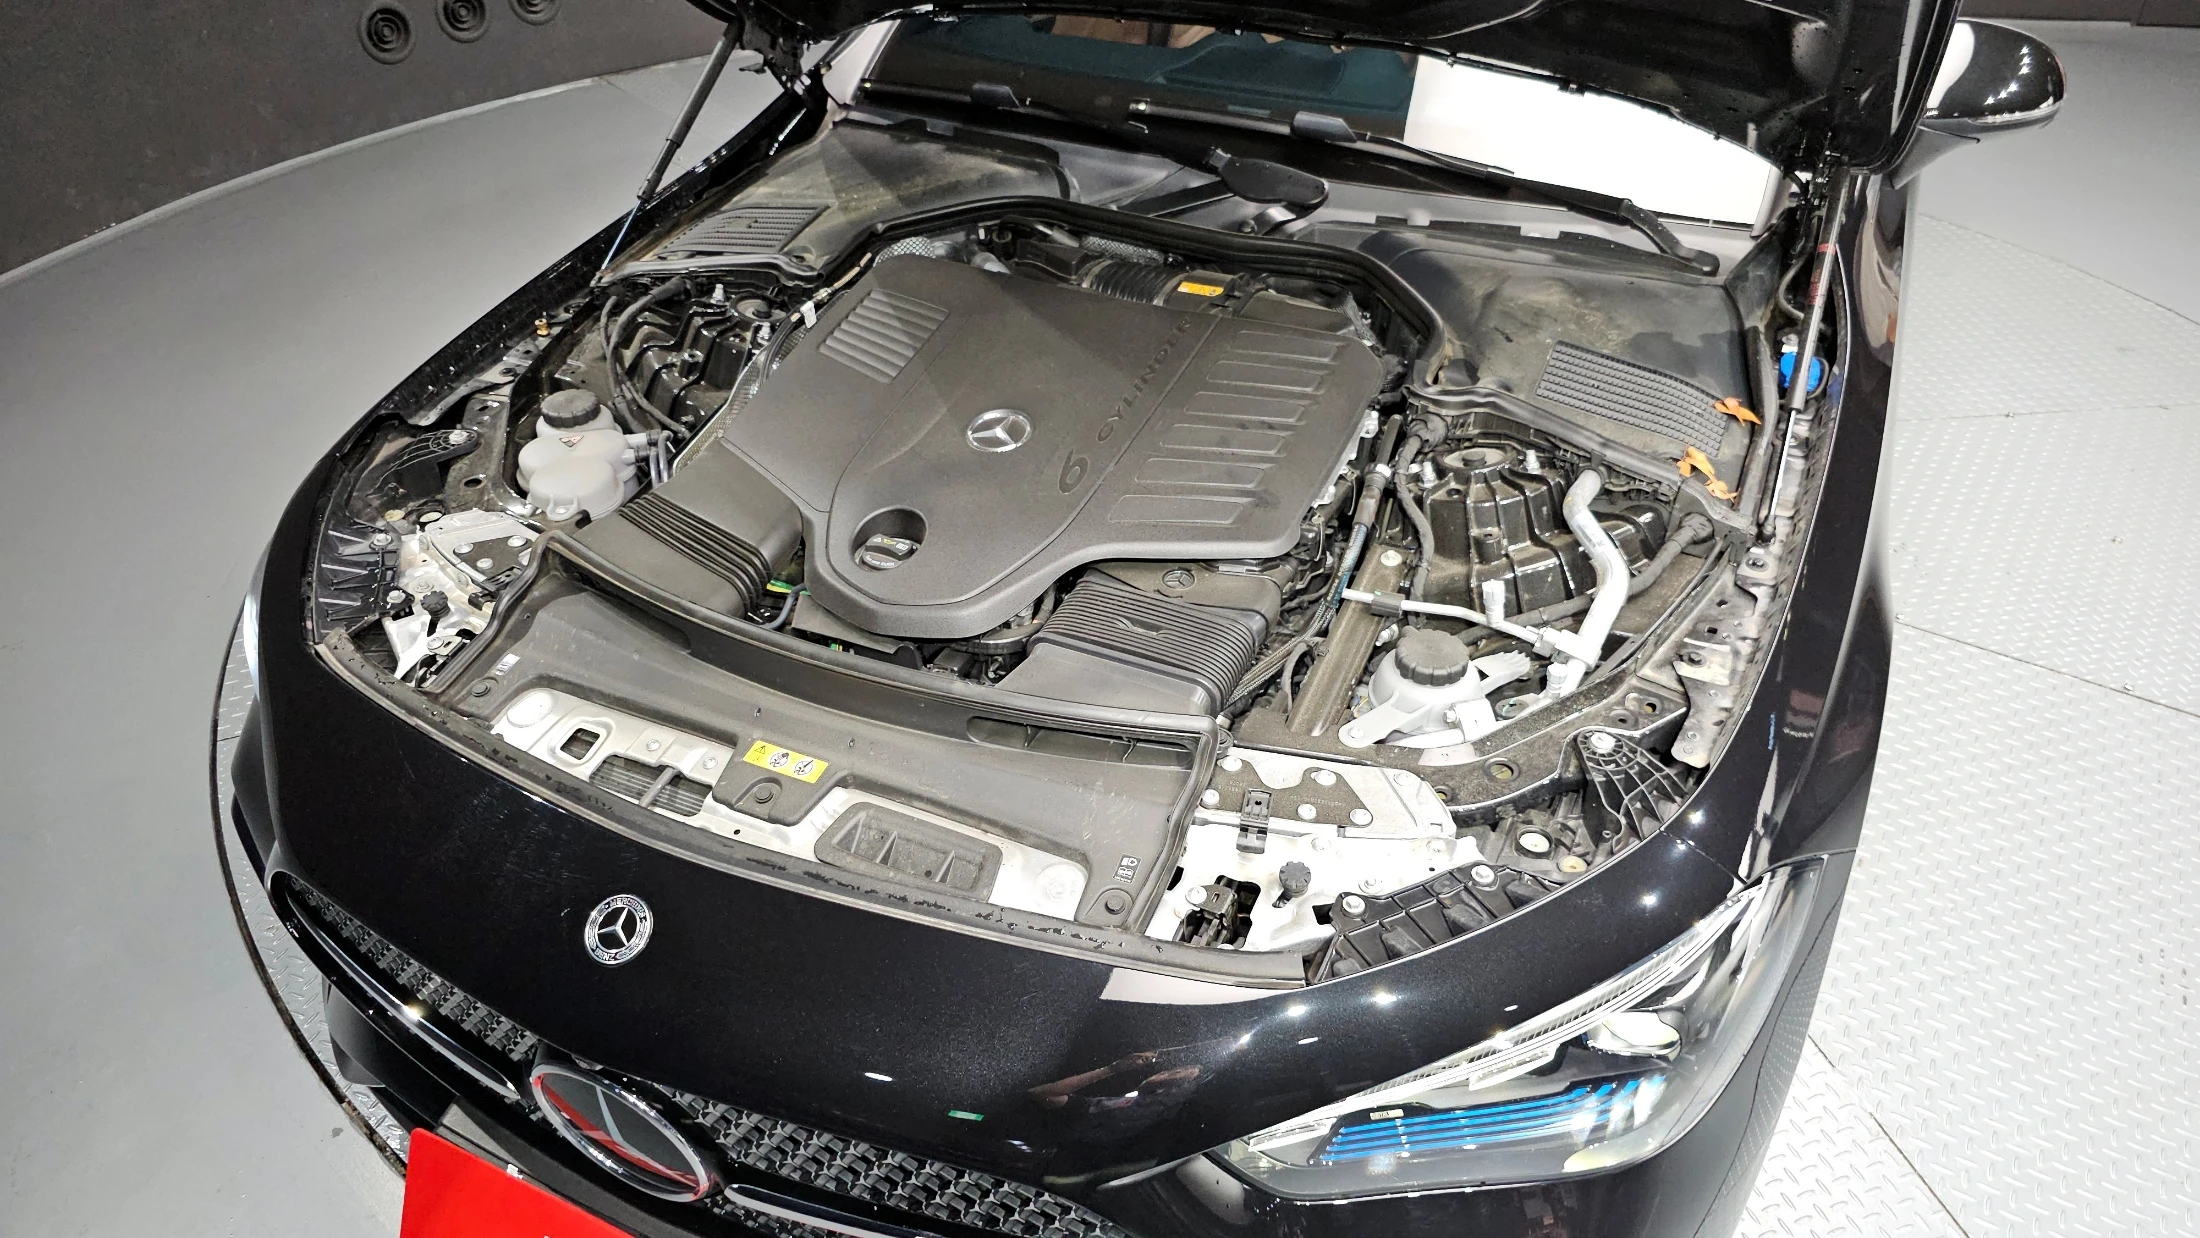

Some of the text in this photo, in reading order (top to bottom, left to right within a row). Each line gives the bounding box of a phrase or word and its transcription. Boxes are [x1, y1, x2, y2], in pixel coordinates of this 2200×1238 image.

[1058, 317, 1191, 495] 6 CYLINDER
[609, 897, 646, 919] MERCEDES
[594, 947, 616, 961] BENZ
